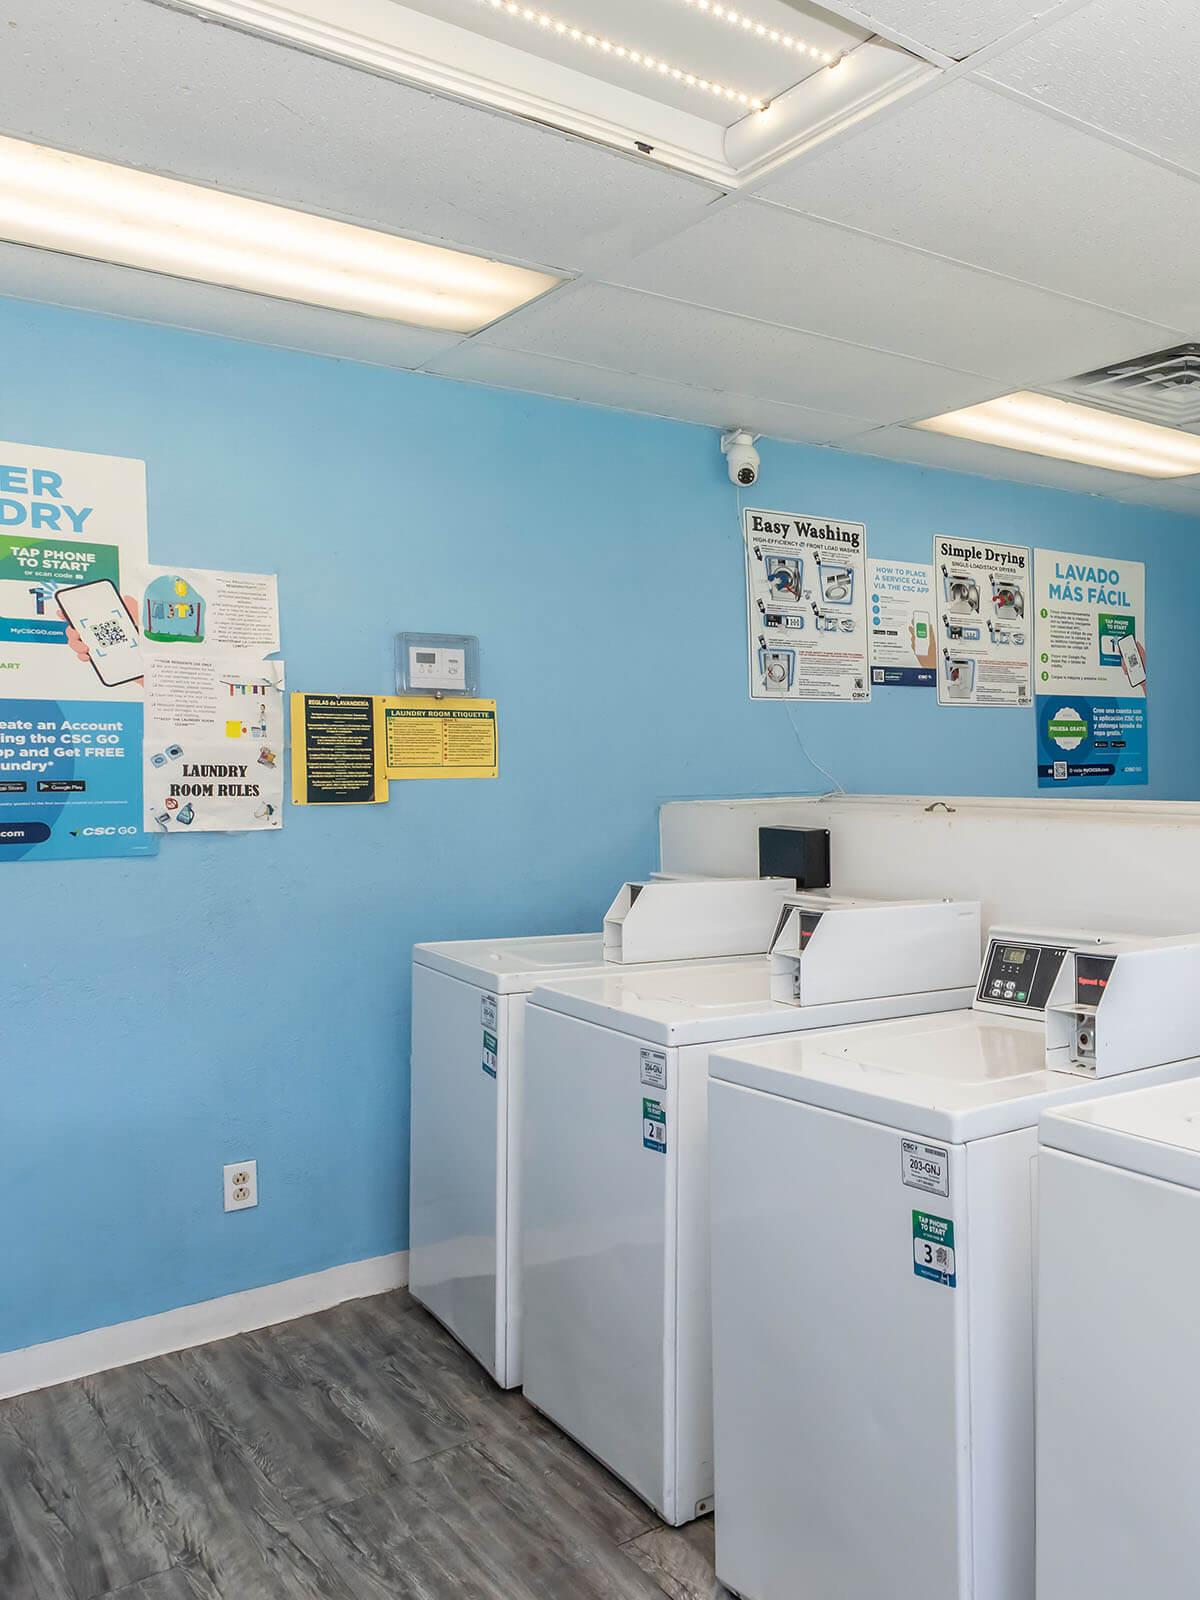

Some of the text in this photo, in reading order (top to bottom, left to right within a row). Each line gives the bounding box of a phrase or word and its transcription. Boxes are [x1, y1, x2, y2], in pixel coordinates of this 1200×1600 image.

[0, 465, 64, 499] ER
[0, 498, 94, 533] DRY
[752, 516, 860, 548] Easy Washing
[10, 546, 96, 563] TAP PHONE
[941, 543, 1025, 568] Simple Drying
[17, 557, 90, 571] TO START
[882, 575, 910, 583] SERVICE
[1056, 563, 1119, 585] LAVADO
[1049, 581, 1130, 607] MÁS FÁCIL
[37, 721, 56, 730] an
[61, 720, 124, 731] Account
[30, 733, 56, 744] the
[61, 734, 92, 744] CSC
[96, 734, 119, 744] GO
[20, 747, 49, 757] and
[53, 747, 80, 757] Get
[85, 747, 125, 758] FREE
[182, 764, 248, 777] LAUNDRY
[51, 785, 71, 793] Google
[170, 784, 260, 797] ROOM RULES
[83, 826, 137, 837] CSC GO
[649, 1122, 654, 1138] 2
[903, 1142, 914, 1150] CSC
[910, 1158, 941, 1177] 203-GNJ
[919, 1215, 948, 1231] TAP PHONE
[921, 1223, 928, 1231] TO
[929, 1225, 945, 1237] START
[924, 1244, 932, 1264] 3
